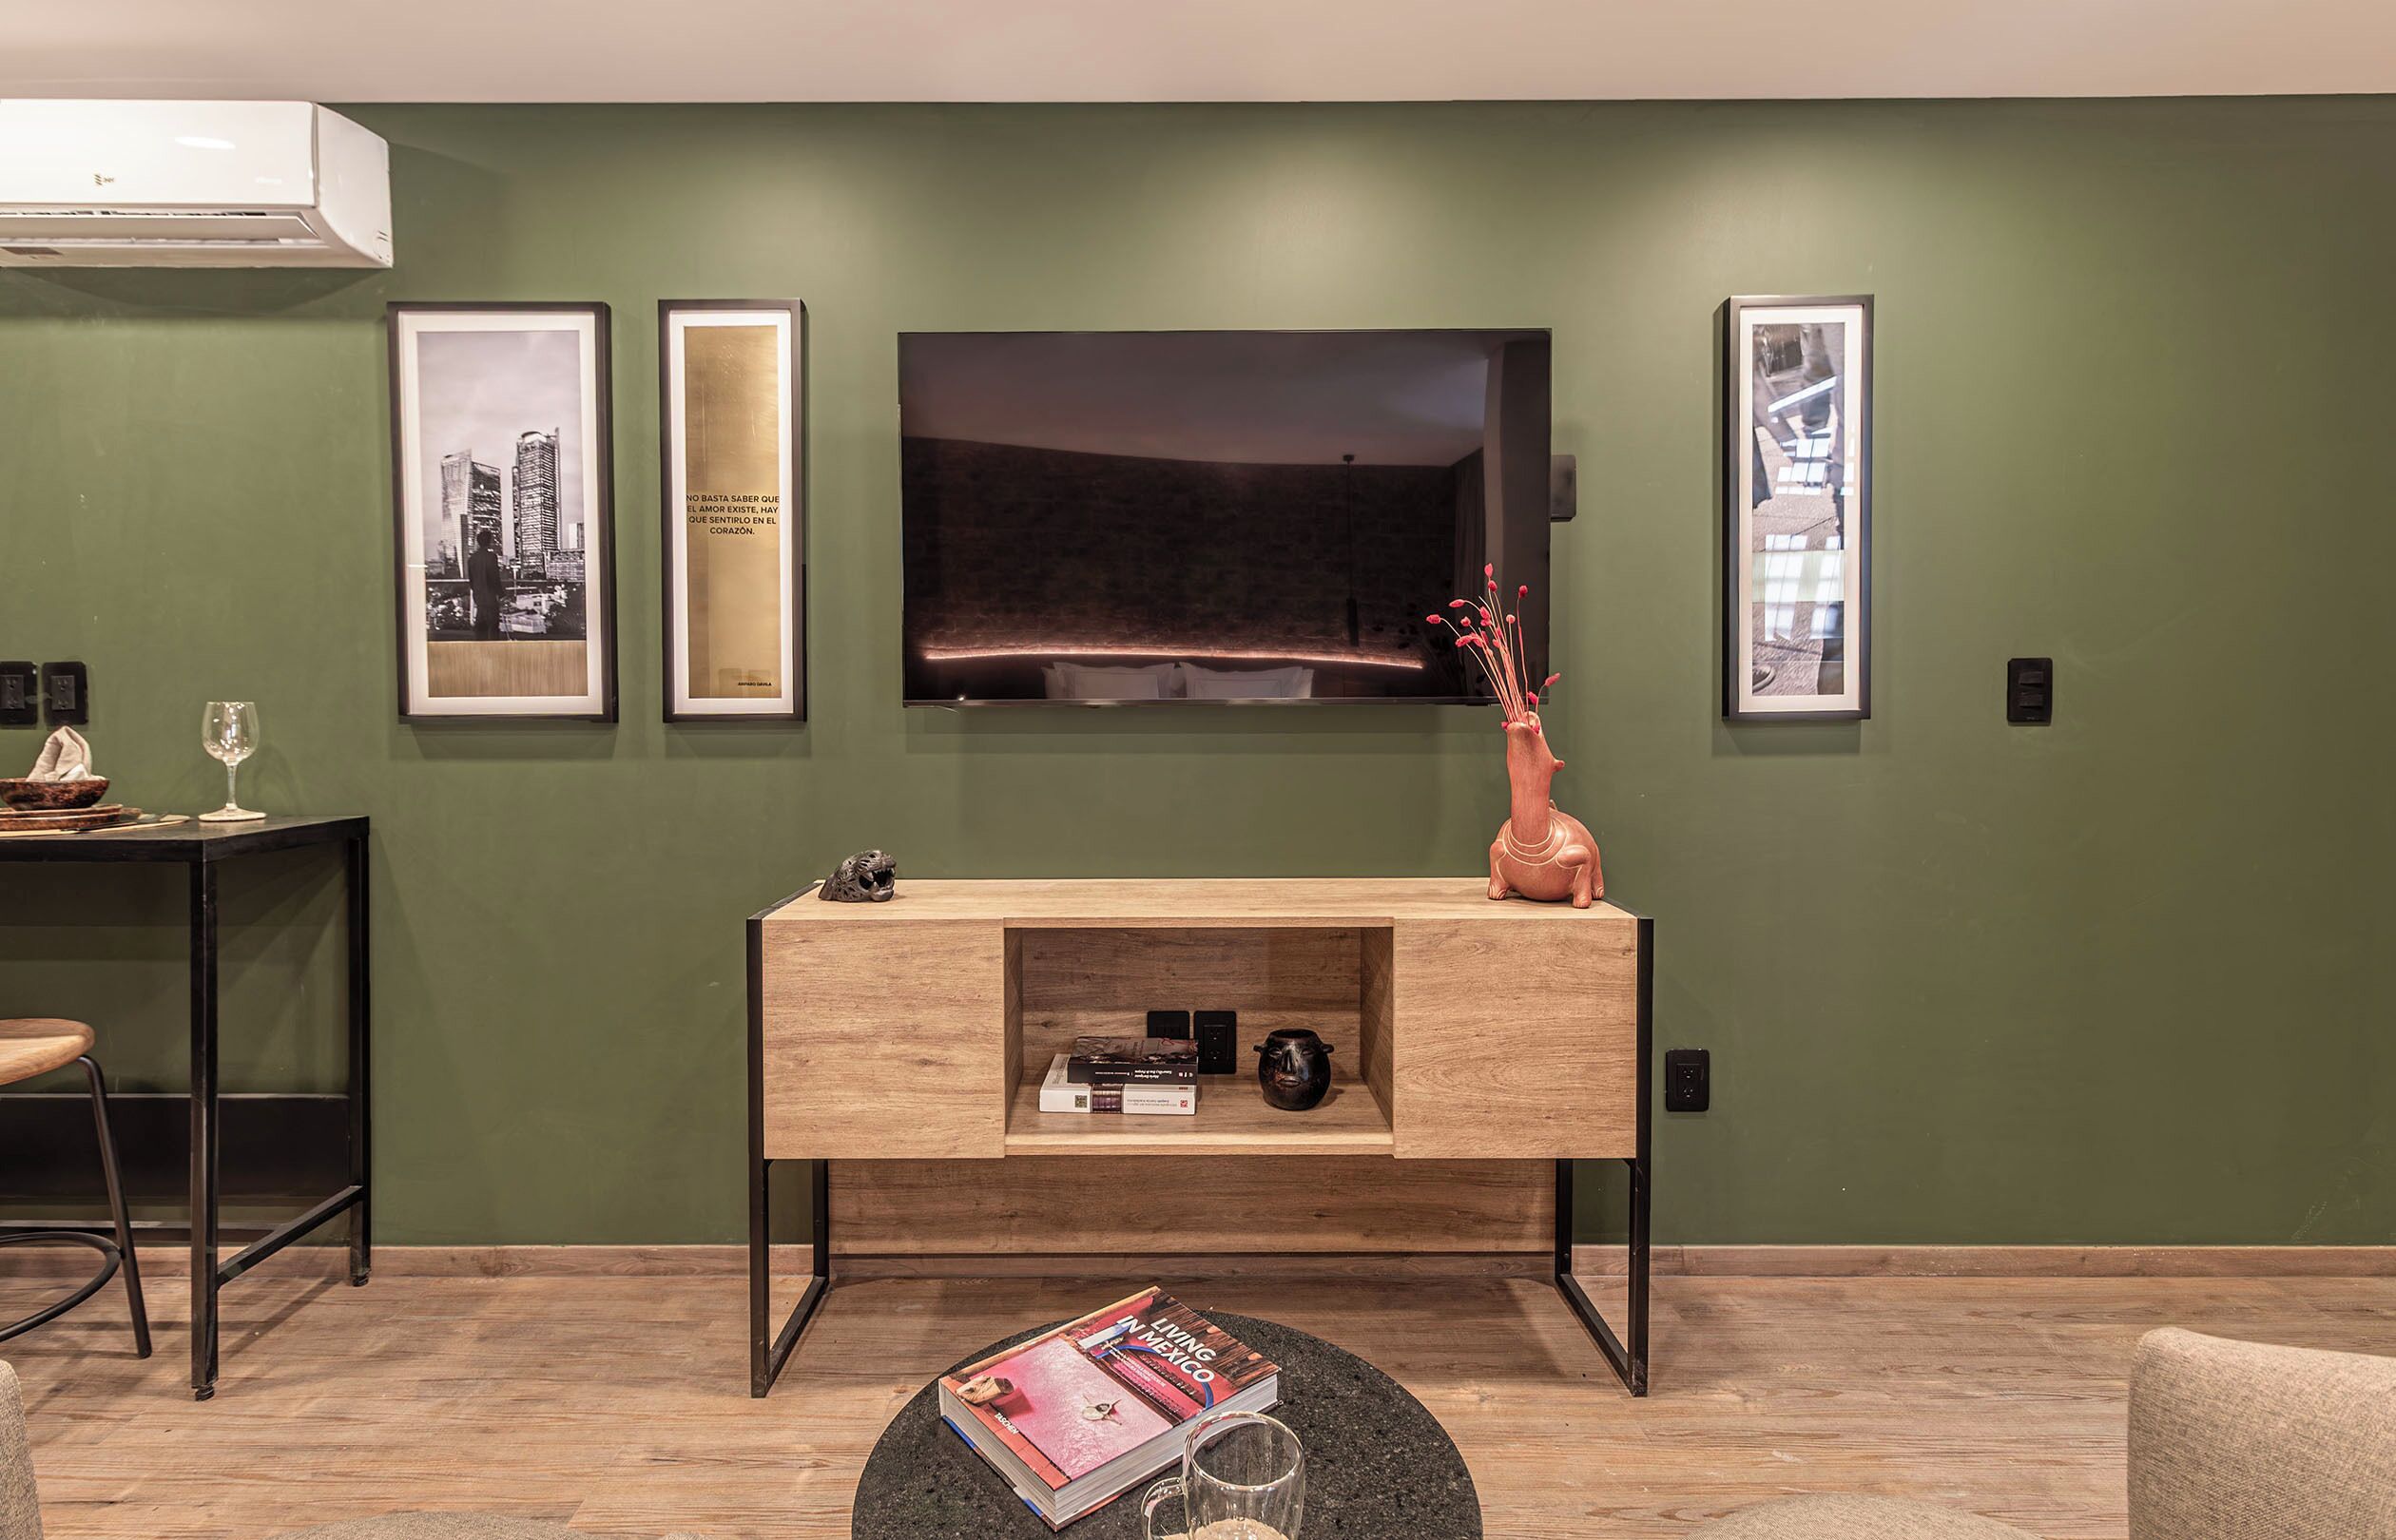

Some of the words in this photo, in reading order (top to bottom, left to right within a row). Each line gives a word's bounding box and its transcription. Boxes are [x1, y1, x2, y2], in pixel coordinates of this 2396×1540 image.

[701, 494, 729, 503] BASTA
[699, 505, 725, 513] AMOR
[727, 506, 759, 514] EXISTE,
[688, 515, 707, 524] QUE
[752, 516, 764, 525] EN
[709, 526, 756, 535] CORAZÓN.
[1150, 1318, 1217, 1361] LIVING
[1116, 1315, 1147, 1335] IN
[1137, 1330, 1215, 1383] MEXICO
